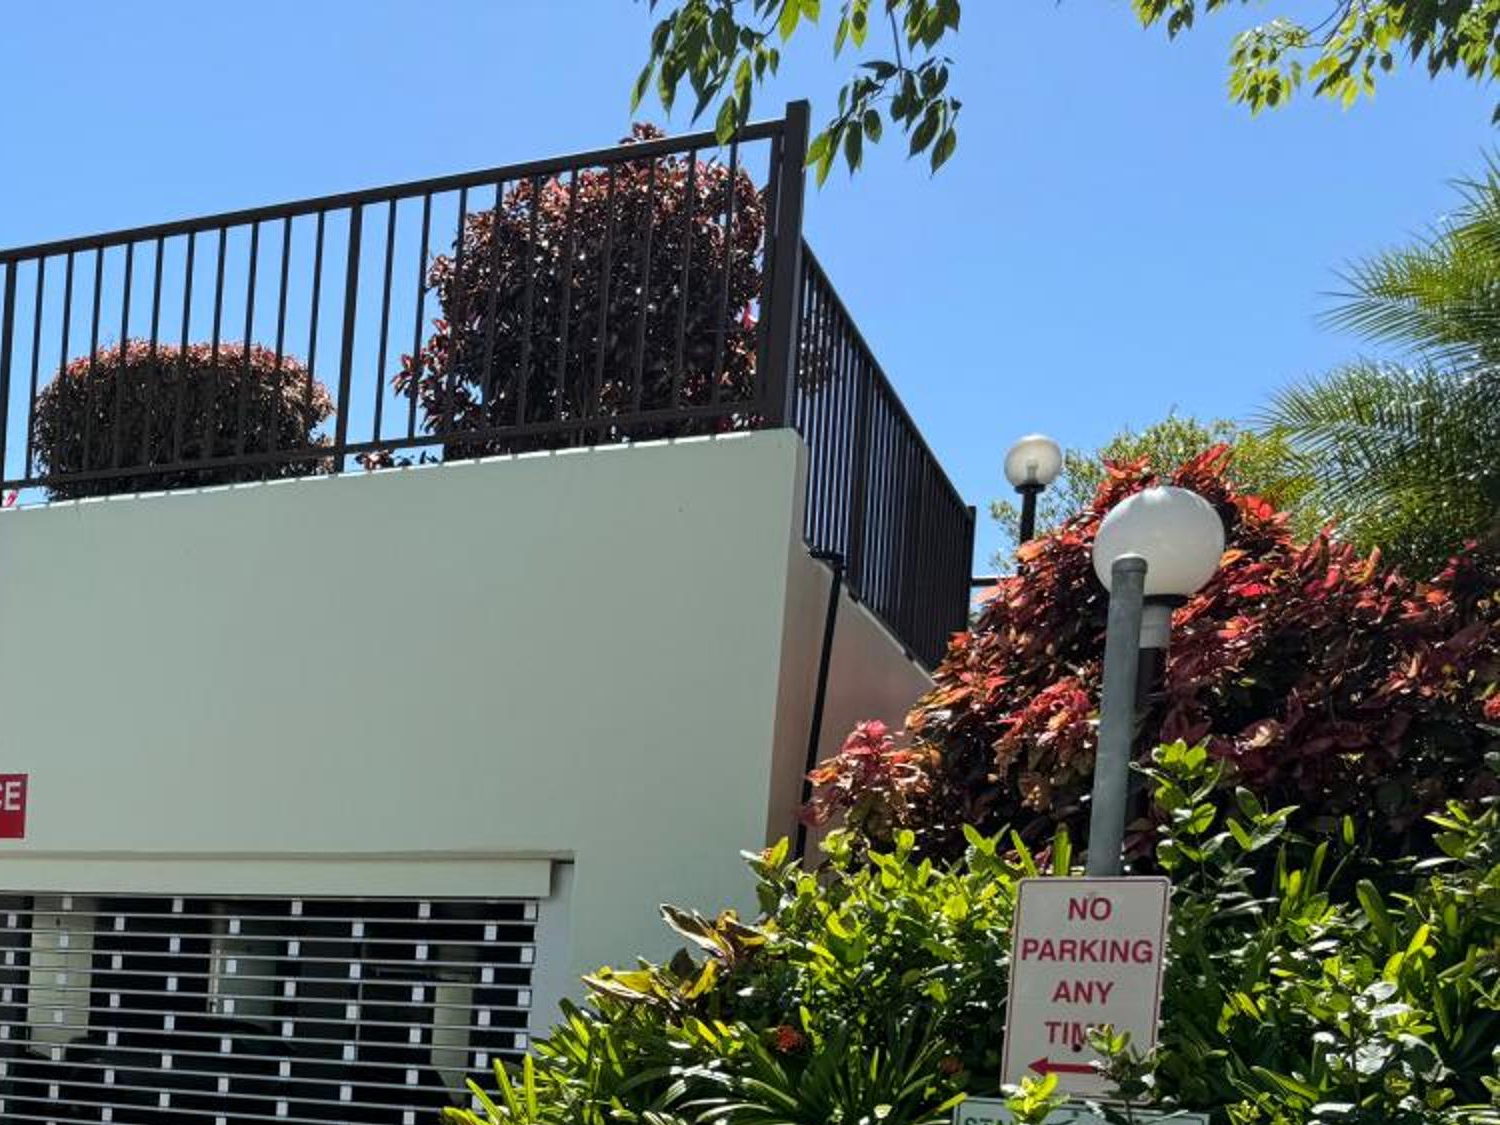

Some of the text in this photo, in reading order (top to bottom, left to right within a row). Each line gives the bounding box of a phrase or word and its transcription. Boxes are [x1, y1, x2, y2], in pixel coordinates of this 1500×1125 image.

[1067, 897, 1112, 921] NO
[1020, 938, 1154, 964] PARKING
[1052, 980, 1115, 1005] ANY
[1044, 1021, 1114, 1046] TIM
